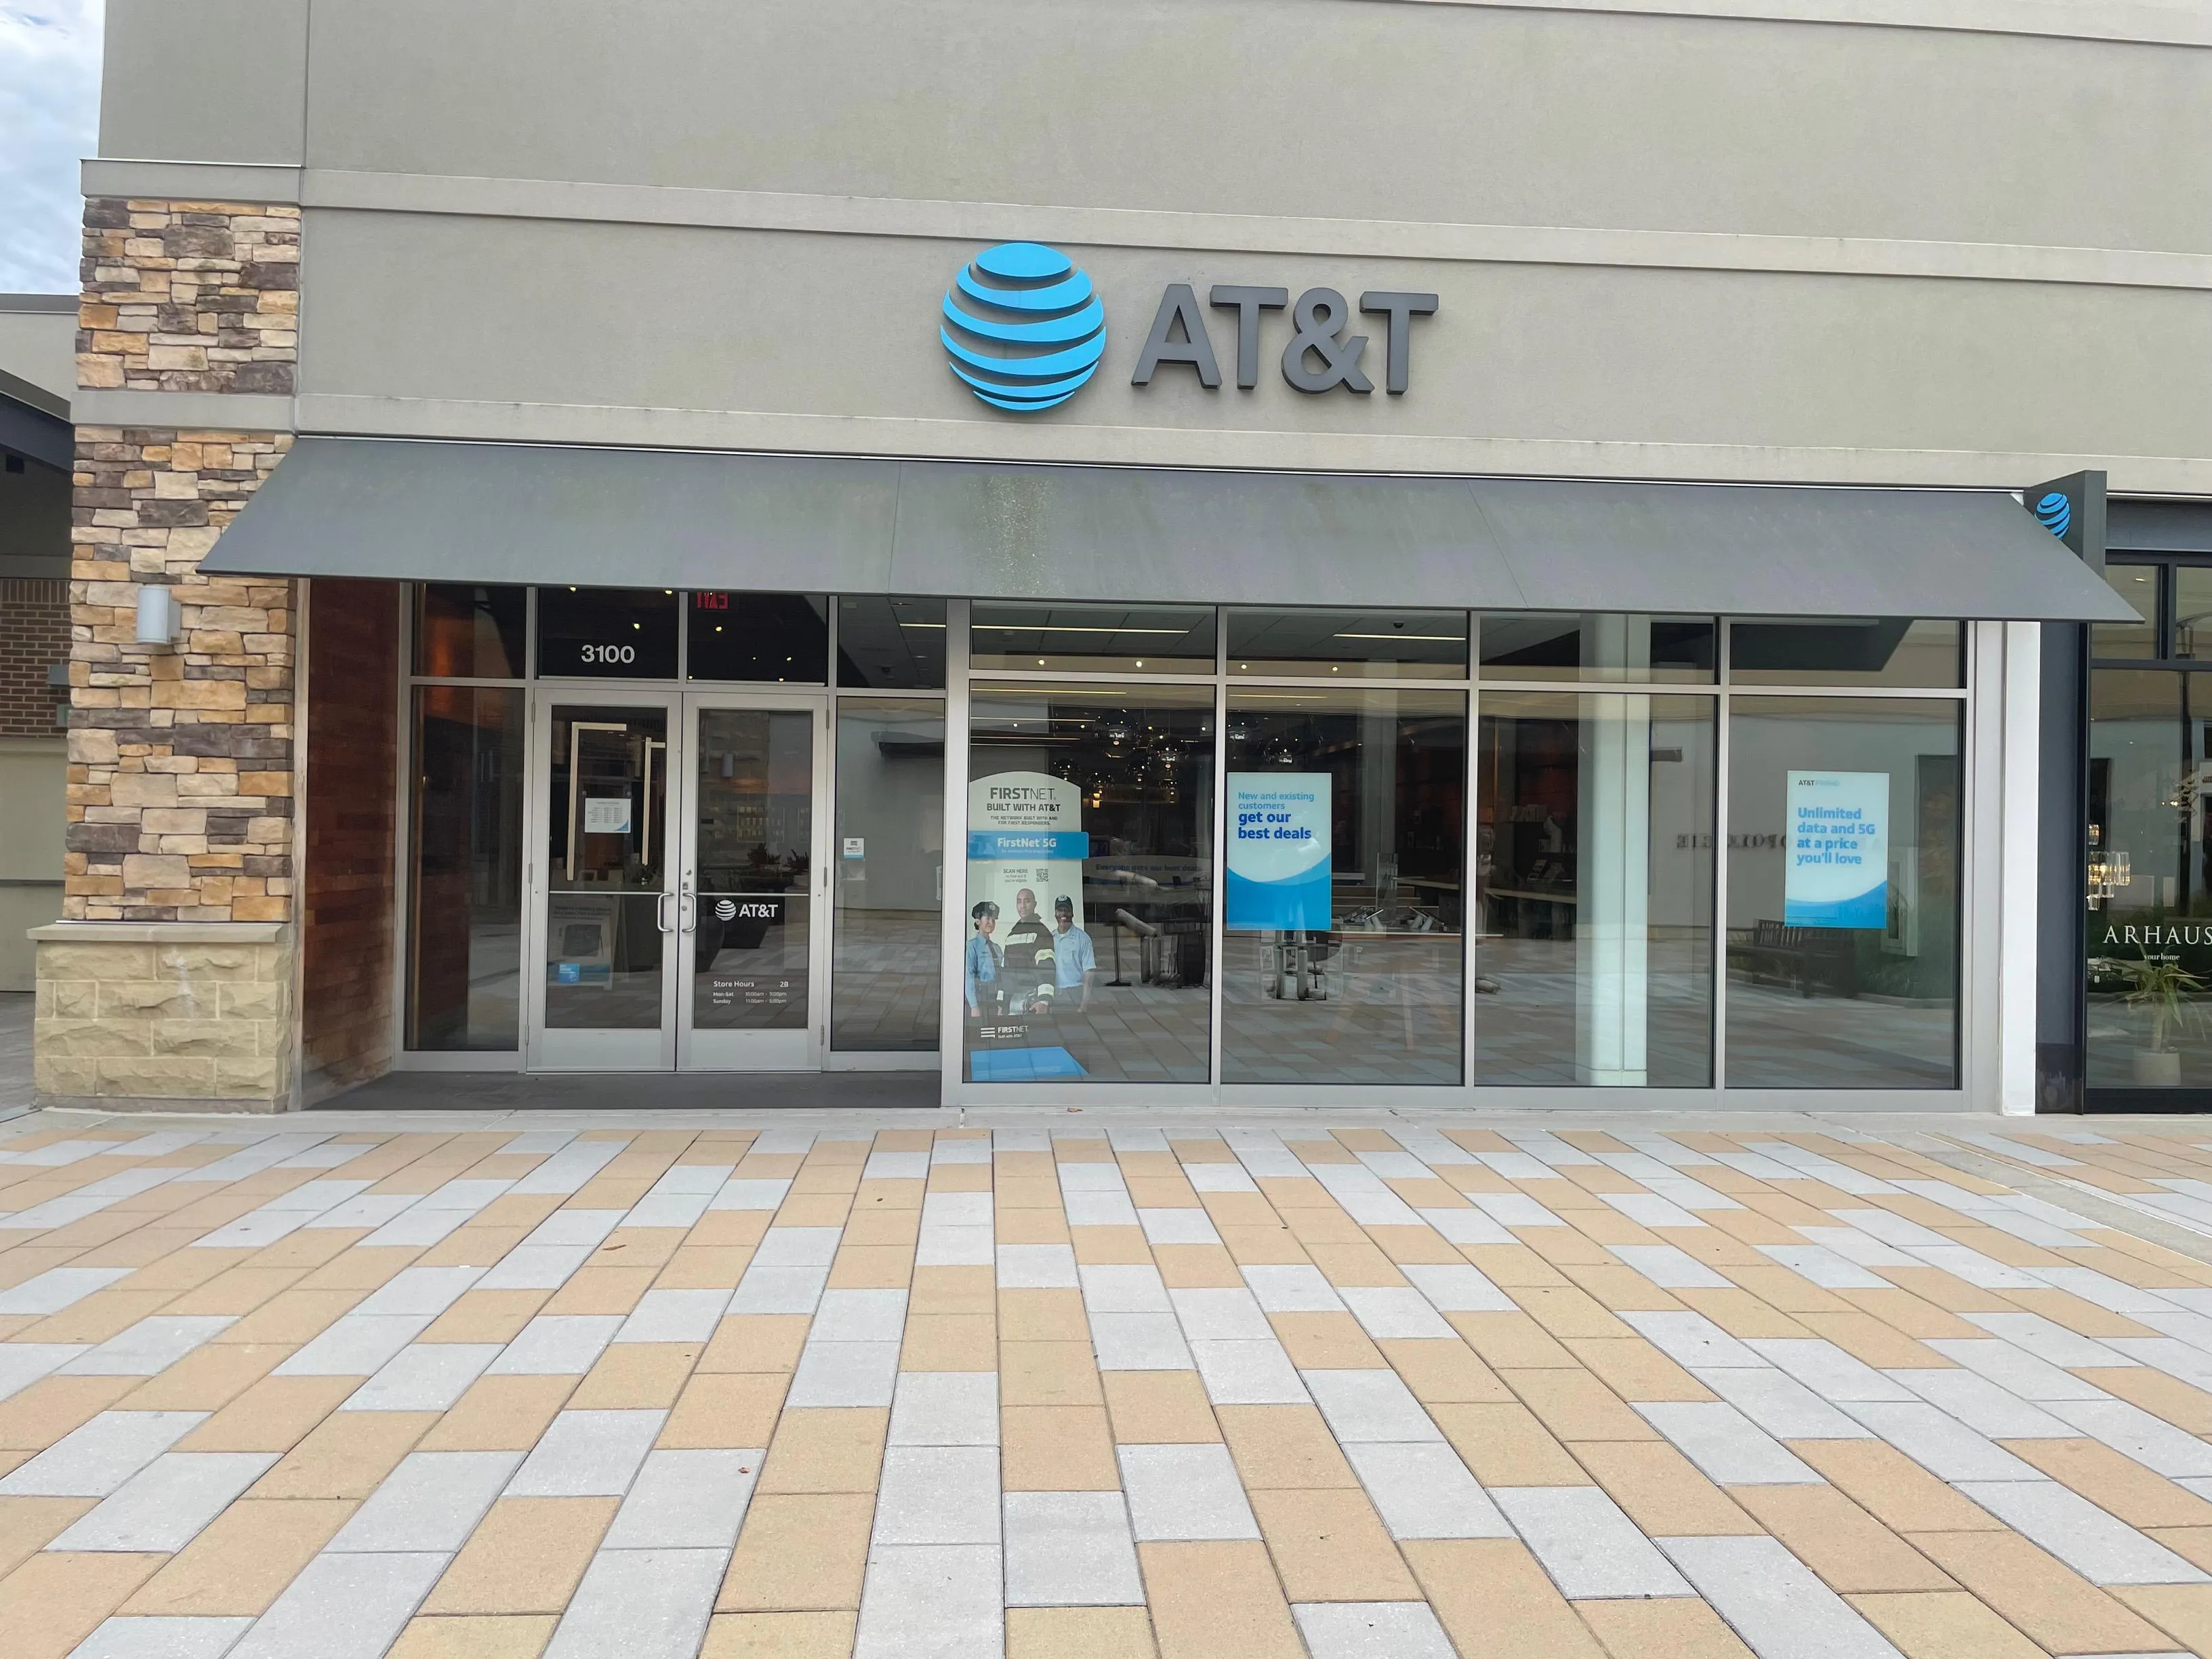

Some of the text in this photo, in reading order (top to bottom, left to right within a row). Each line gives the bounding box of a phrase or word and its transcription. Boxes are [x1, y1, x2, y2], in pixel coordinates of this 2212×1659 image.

[1131, 283, 1439, 395] AT&T
[581, 644, 636, 663] 3100
[1279, 792, 1315, 802] existing
[987, 803, 1061, 812] BUILT WITH AT&T
[1798, 806, 1862, 820] Unlimited
[1239, 812, 1292, 825] get our
[1238, 827, 1312, 839] best deals
[1797, 821, 1875, 834] data and 5G
[998, 838, 1057, 847] FirstNet 5G
[1797, 837, 1858, 852] at a price
[1797, 852, 1862, 866] you'll love
[739, 904, 778, 918] AT&T
[2102, 925, 2212, 945] ARHAUS
[2160, 952, 2180, 960] home
